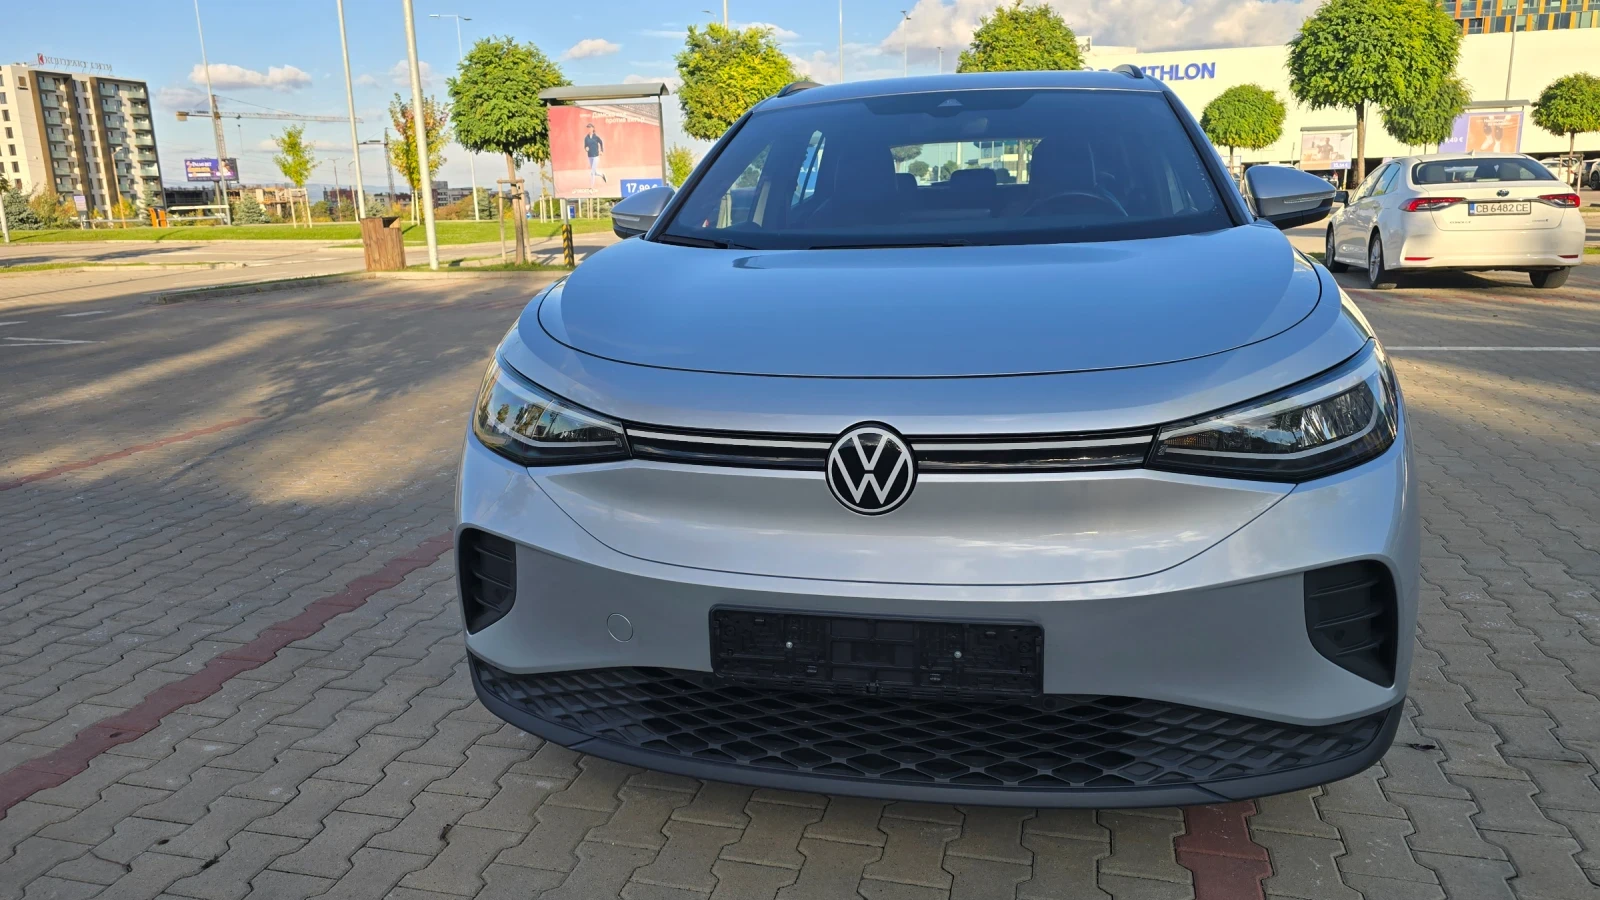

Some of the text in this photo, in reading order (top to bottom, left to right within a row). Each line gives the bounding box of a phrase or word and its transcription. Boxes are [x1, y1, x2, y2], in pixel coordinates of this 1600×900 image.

[1139, 62, 1216, 81] THLON
[1476, 204, 1529, 213] CB 6482 CE
